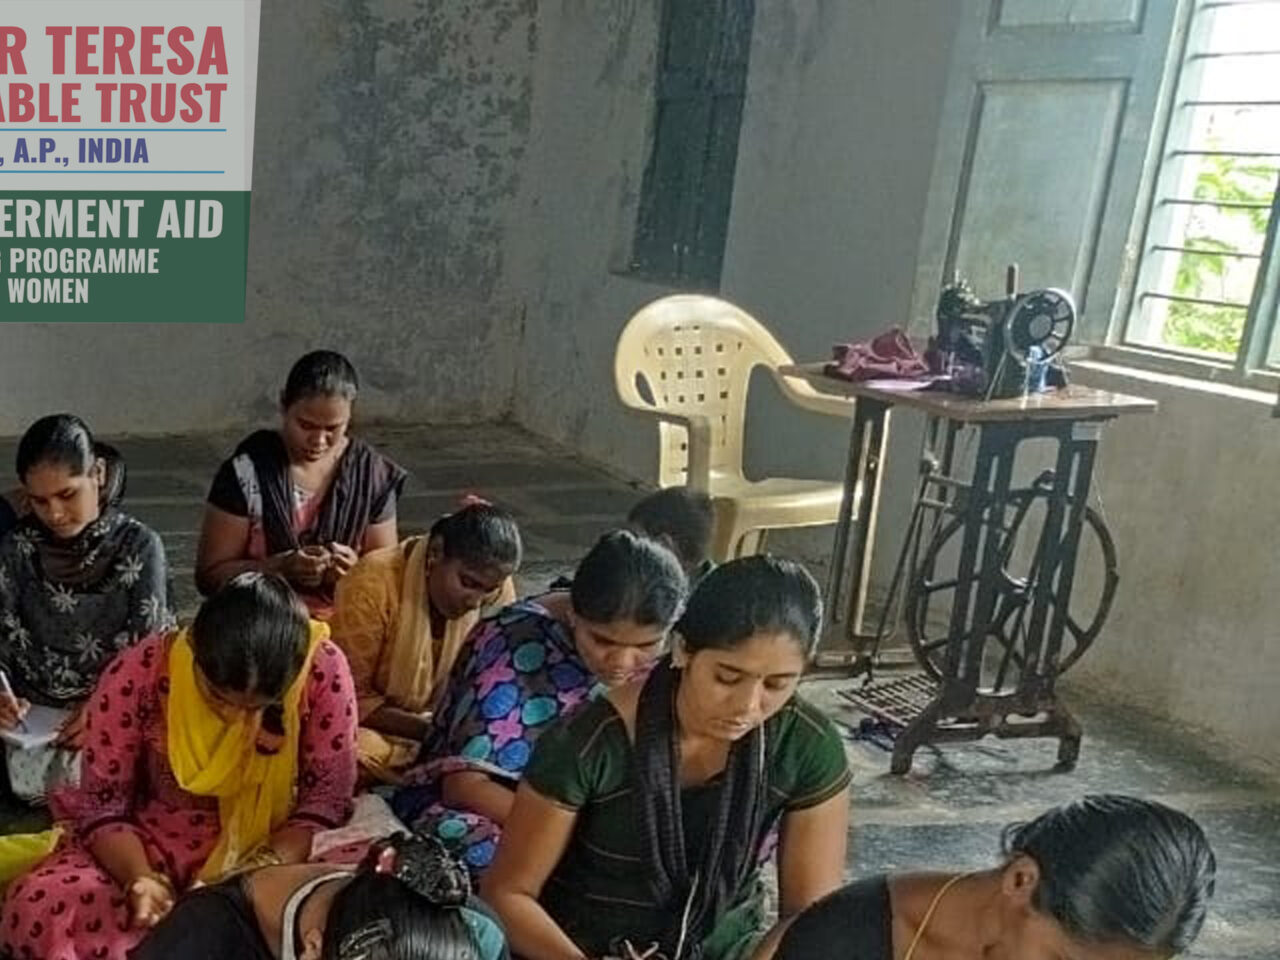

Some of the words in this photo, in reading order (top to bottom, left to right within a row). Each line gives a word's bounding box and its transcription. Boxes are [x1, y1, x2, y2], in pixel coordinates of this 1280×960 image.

[45, 26, 229, 75] TERESA
[95, 82, 228, 123] TRUST
[13, 137, 69, 167] A.P.,
[78, 138, 149, 164] INDIA
[156, 199, 224, 239] AID
[9, 248, 160, 274] PROGRAMME
[7, 278, 89, 304] WOMEN
